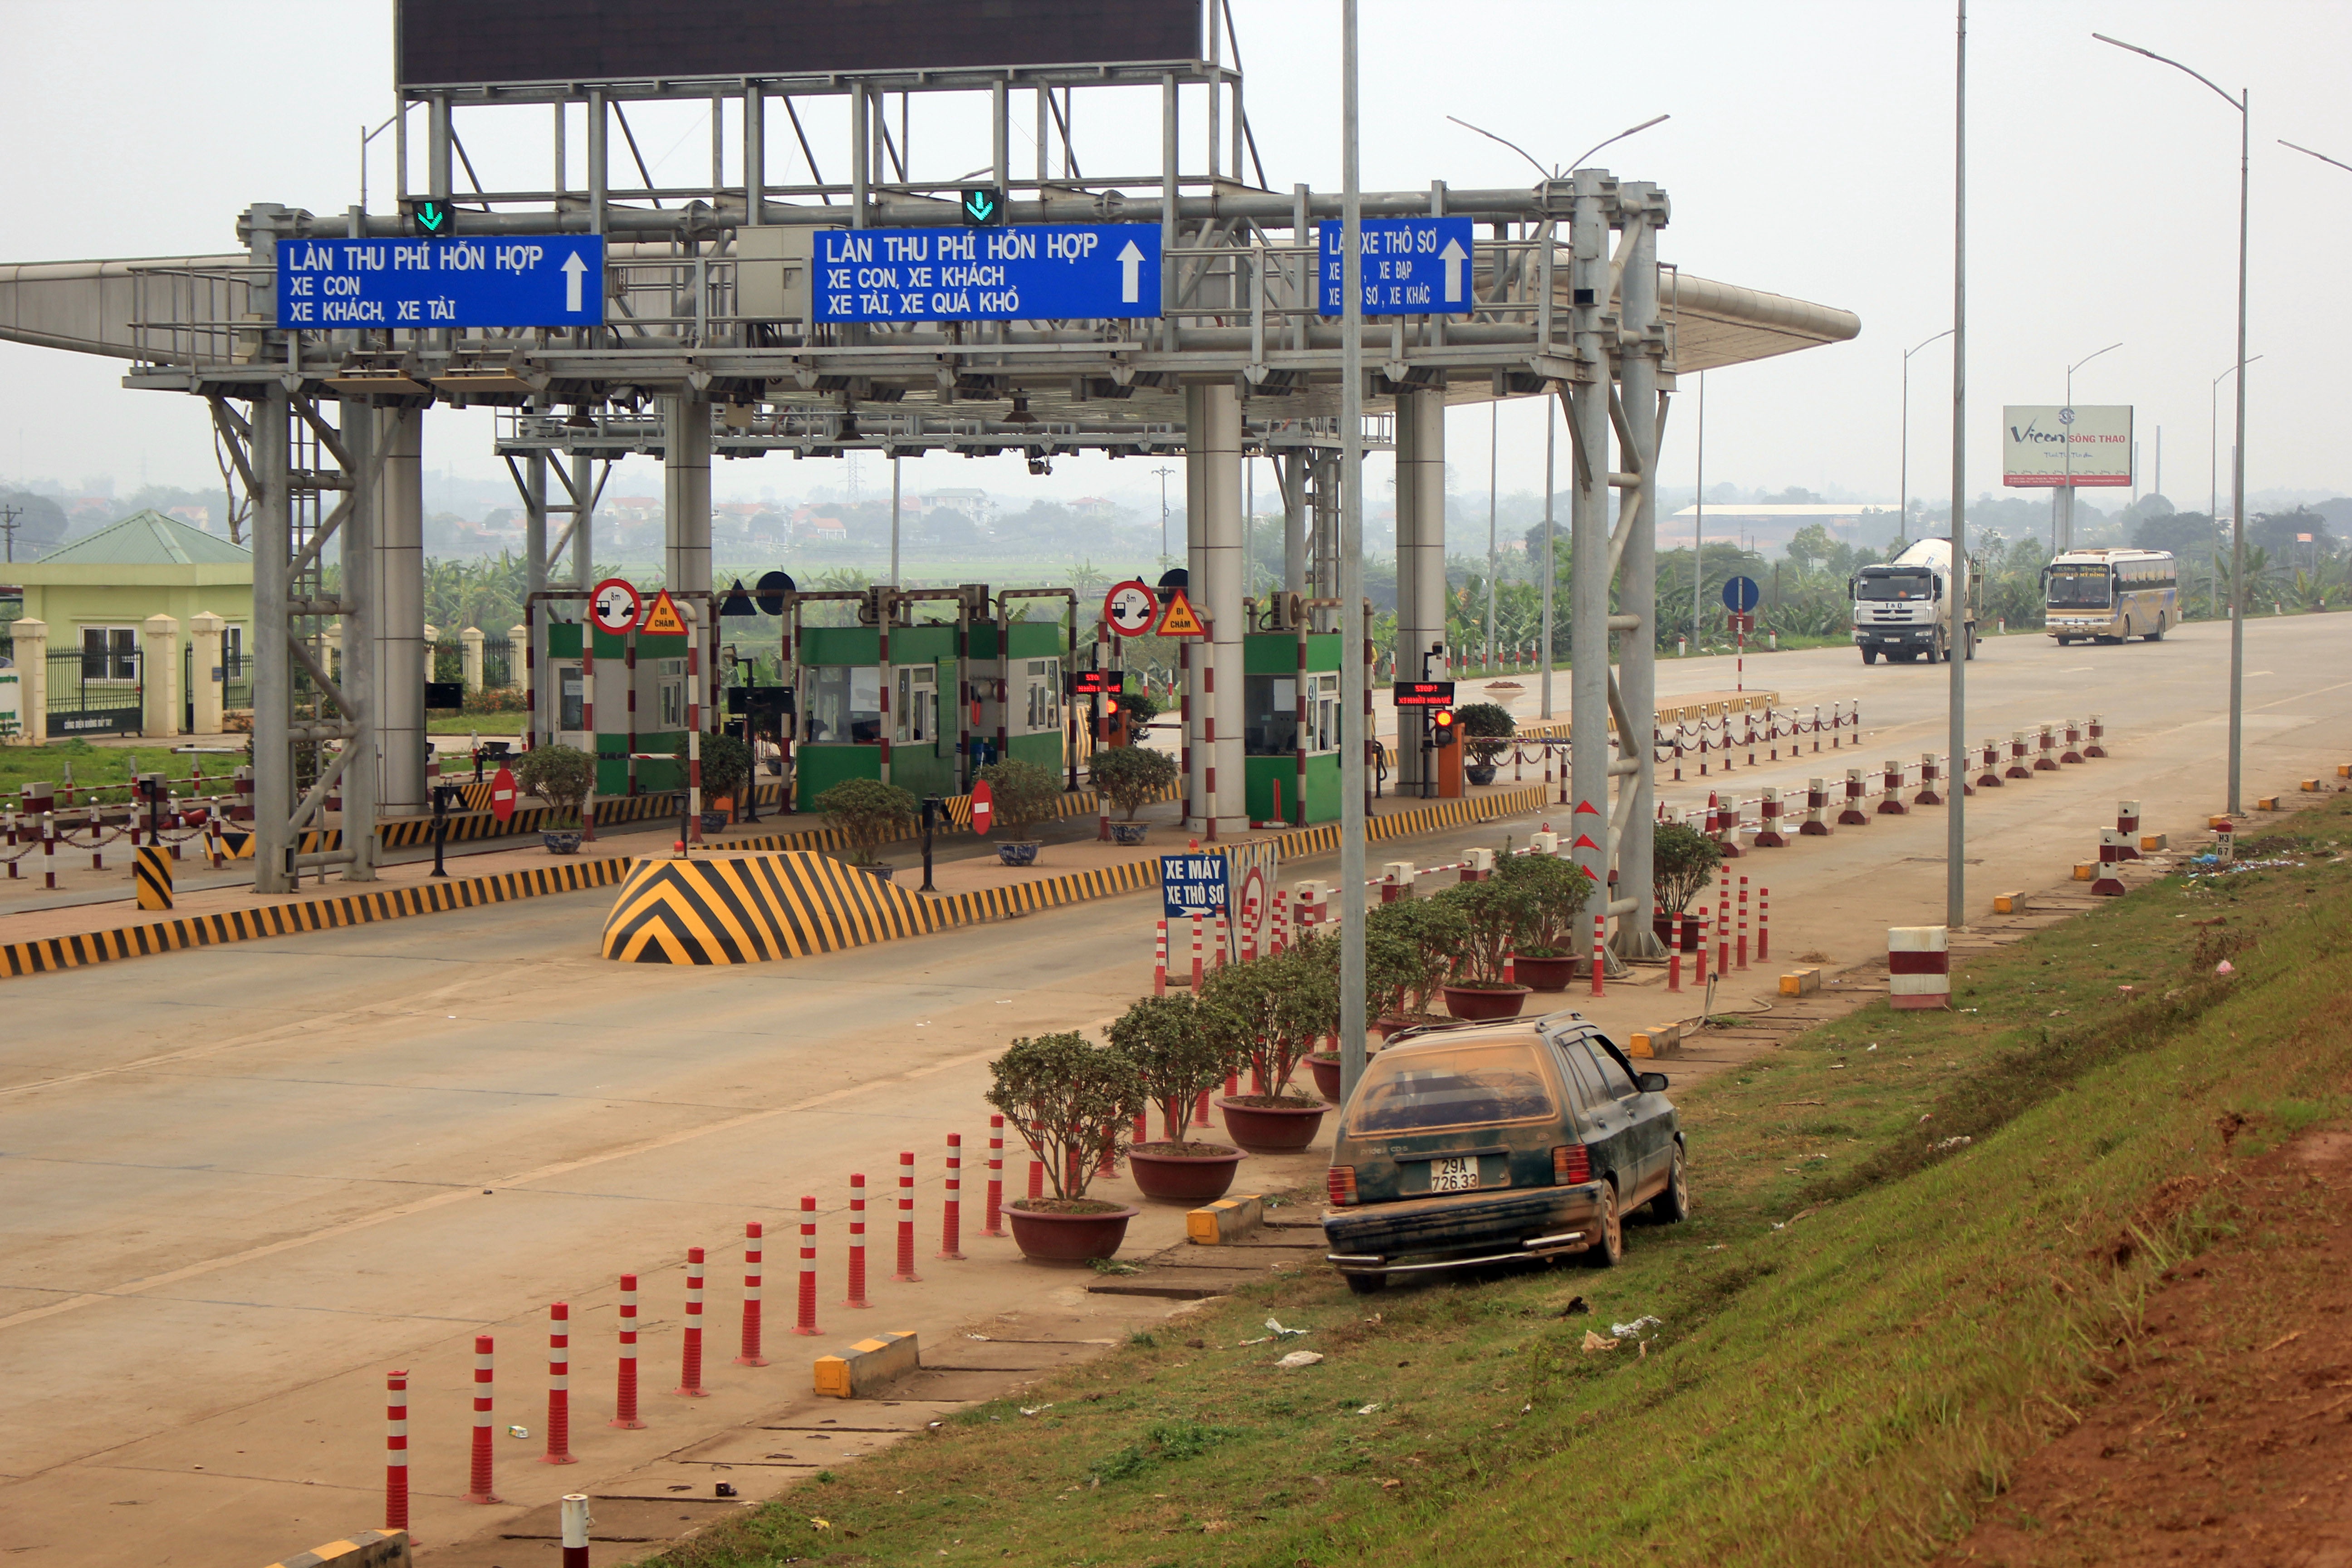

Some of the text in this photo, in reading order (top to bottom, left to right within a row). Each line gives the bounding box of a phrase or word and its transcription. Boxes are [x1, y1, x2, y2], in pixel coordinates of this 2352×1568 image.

[826, 229, 1098, 265] LÀN THU PHÍ HỖN HỢP
[1329, 225, 1437, 255] LÀ XE THÔ SƠ
[289, 240, 543, 276] LÀN THU PHÍ HỖN HỢP
[827, 262, 1004, 291] XE CON, XE KHÁCH
[1329, 262, 1340, 280] XE
[1379, 261, 1390, 279] XE
[1396, 260, 1412, 280] ĐẠP
[290, 276, 360, 296] XE CON
[1390, 286, 1401, 305] XE
[1406, 282, 1430, 305] KHÁC
[828, 285, 1019, 317] XE TẢI, XE QUÁ KHỔ
[1329, 287, 1340, 306] XE
[290, 296, 456, 322] XE KHÁCH, XE TẢI
[2069, 433, 2096, 443] SÔNG
[2099, 435, 2126, 443] THAO
[611, 592, 621, 601] 8m
[1126, 593, 1136, 603] 8m
[655, 617, 675, 630] CHẬM
[1170, 618, 1191, 630] CHẬM
[2219, 834, 2229, 843] H3
[1165, 856, 1221, 879] XE MÁY
[1166, 882, 1225, 905] XE THÔ SƠ
[1441, 1158, 1467, 1174] 29A
[1432, 1174, 1477, 1191] 726.33
